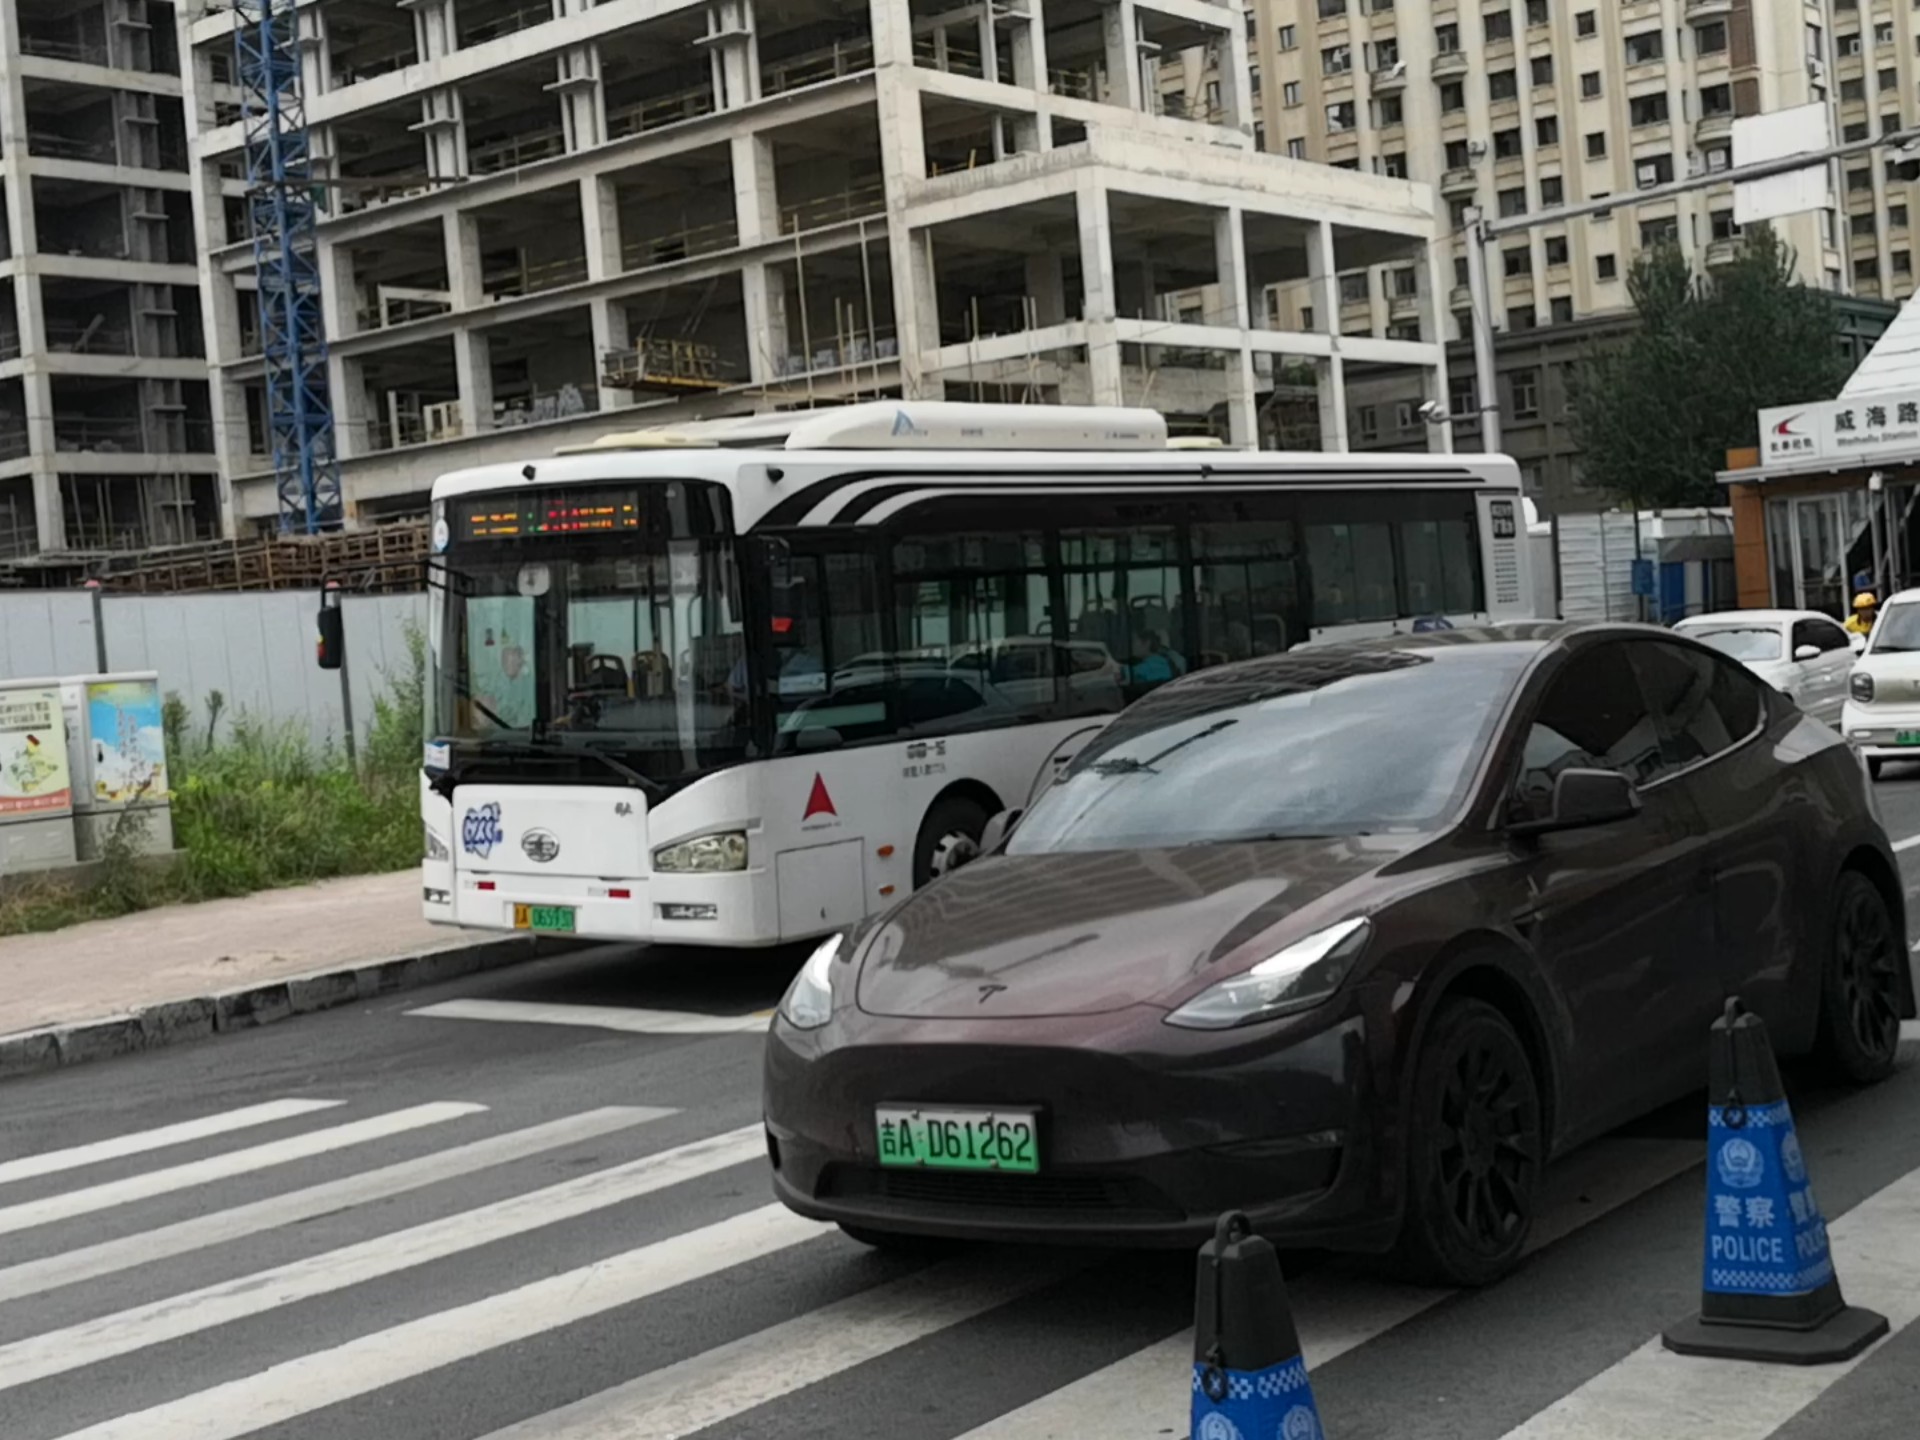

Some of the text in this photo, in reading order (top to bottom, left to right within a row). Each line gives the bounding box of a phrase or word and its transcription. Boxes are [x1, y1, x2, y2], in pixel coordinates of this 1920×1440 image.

[1835, 402, 1919, 433] 威海路
[1714, 1194, 1775, 1228] 警察
[1711, 1235, 1785, 1263] POLICE
